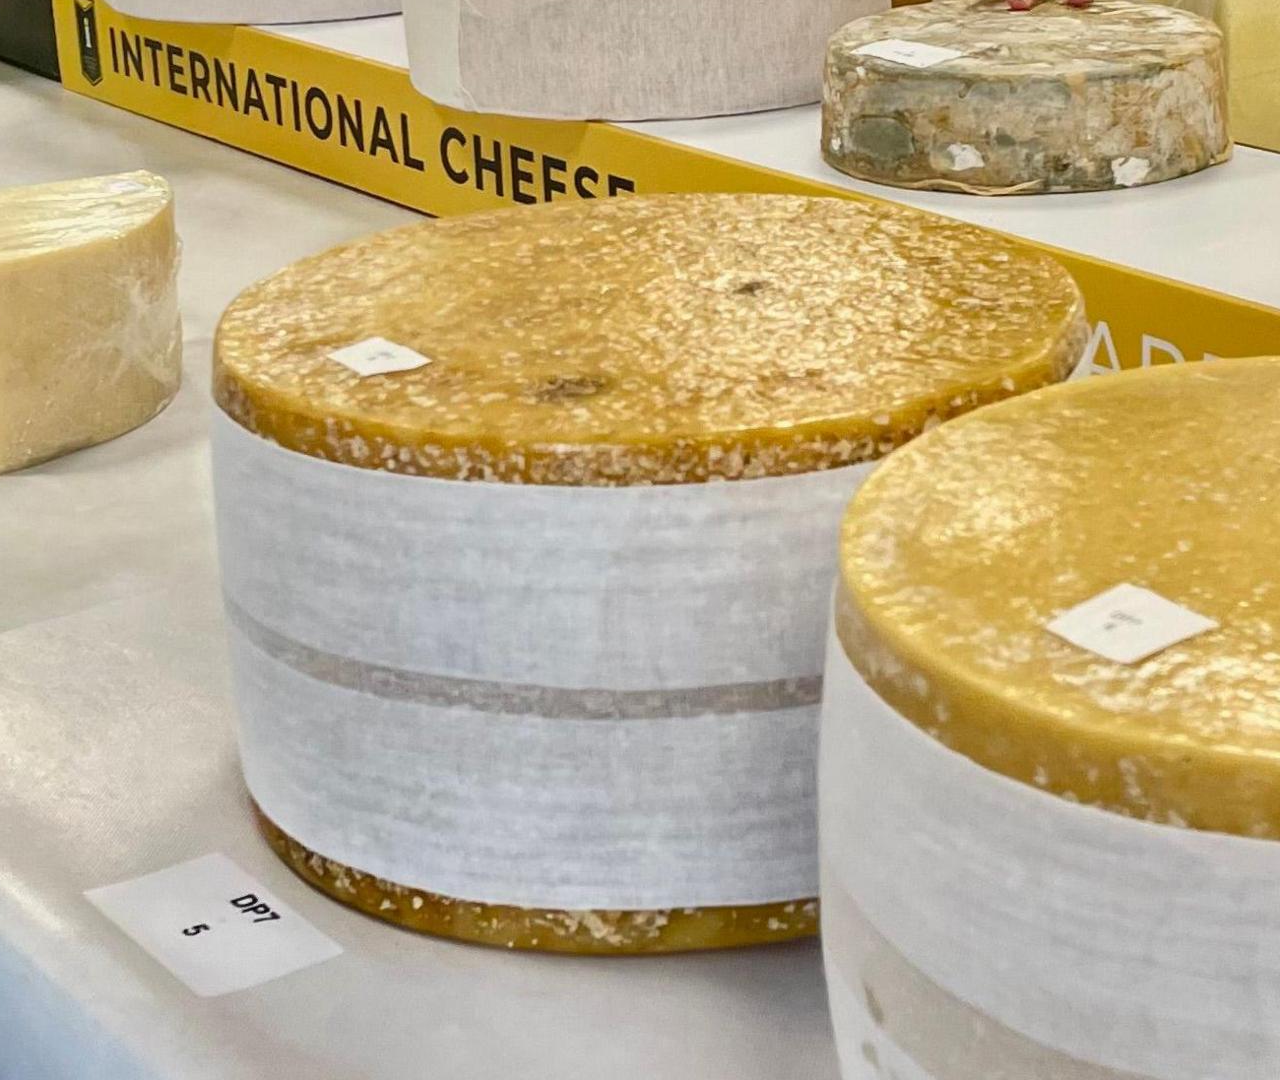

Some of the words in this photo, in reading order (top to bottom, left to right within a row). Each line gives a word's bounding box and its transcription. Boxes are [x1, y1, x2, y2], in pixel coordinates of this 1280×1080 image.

[108, 25, 426, 172] INTERNATIONAL
[229, 893, 281, 924] DP7
[182, 923, 210, 937] 5
